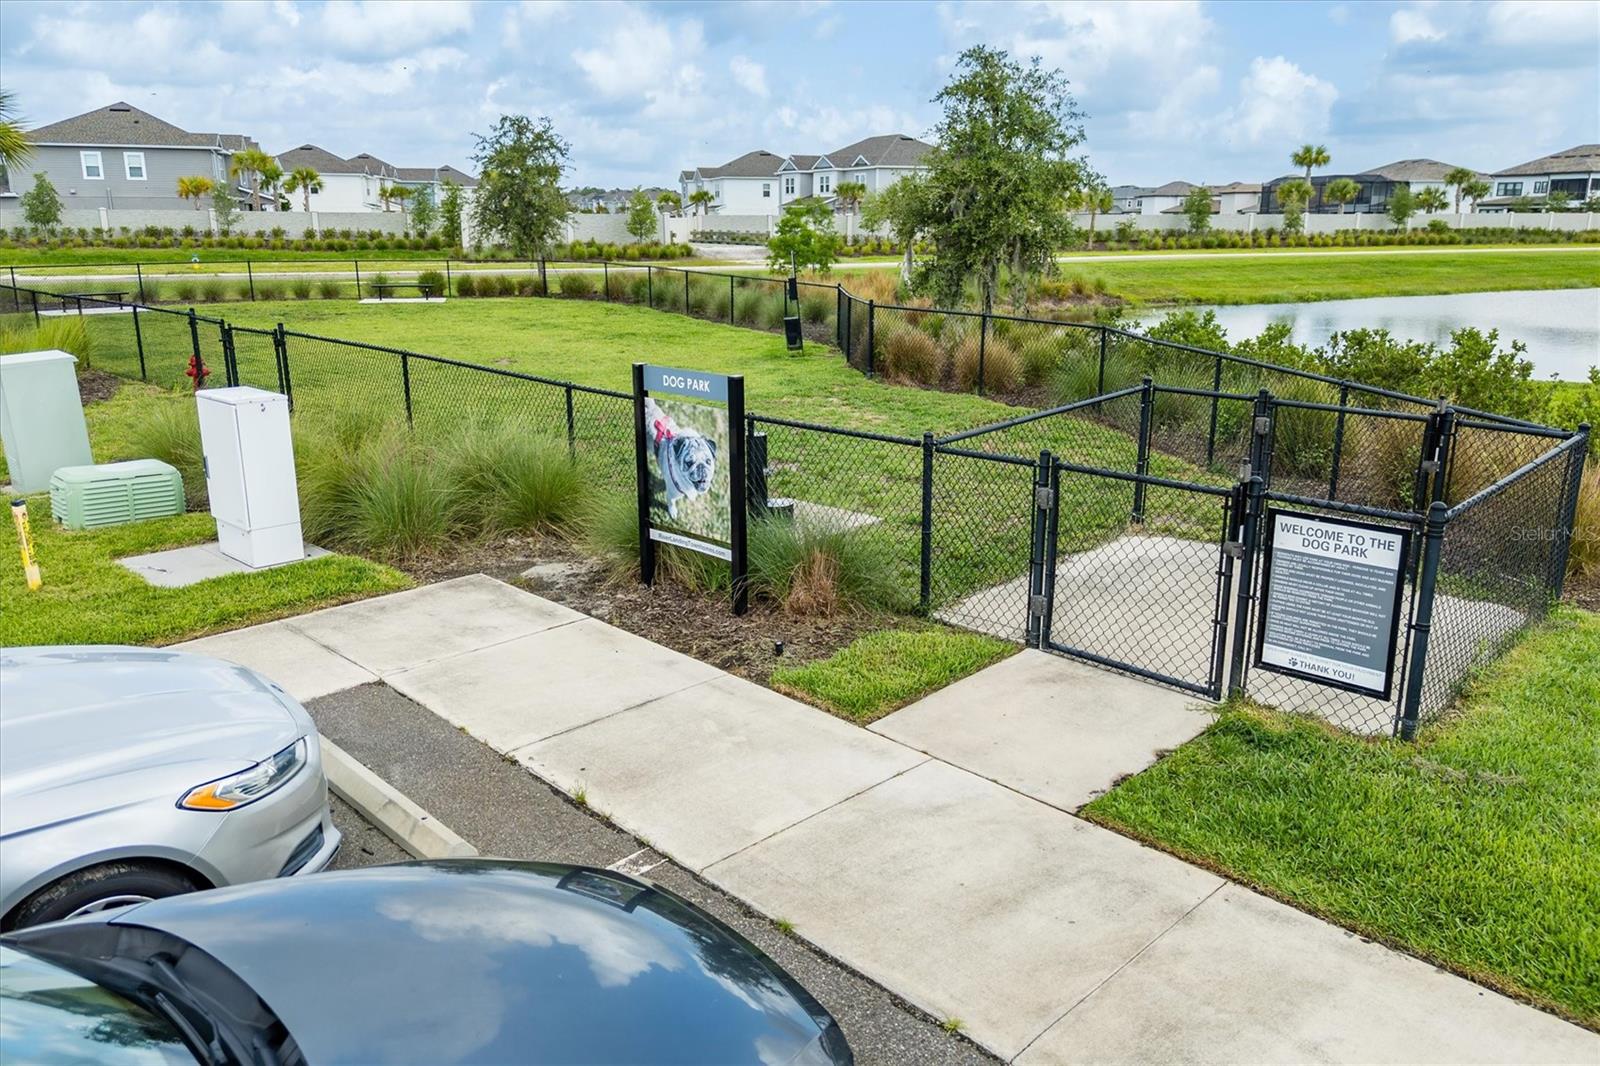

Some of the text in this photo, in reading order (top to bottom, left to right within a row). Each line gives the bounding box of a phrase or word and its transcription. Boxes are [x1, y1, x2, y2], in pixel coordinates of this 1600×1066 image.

[662, 375, 710, 393] DOG PARK
[1280, 522, 1395, 552] WELCOME TO THE
[1302, 537, 1368, 559] DOG PARK
[1300, 660, 1329, 675] THANK
[1332, 669, 1355, 680] YOU!
